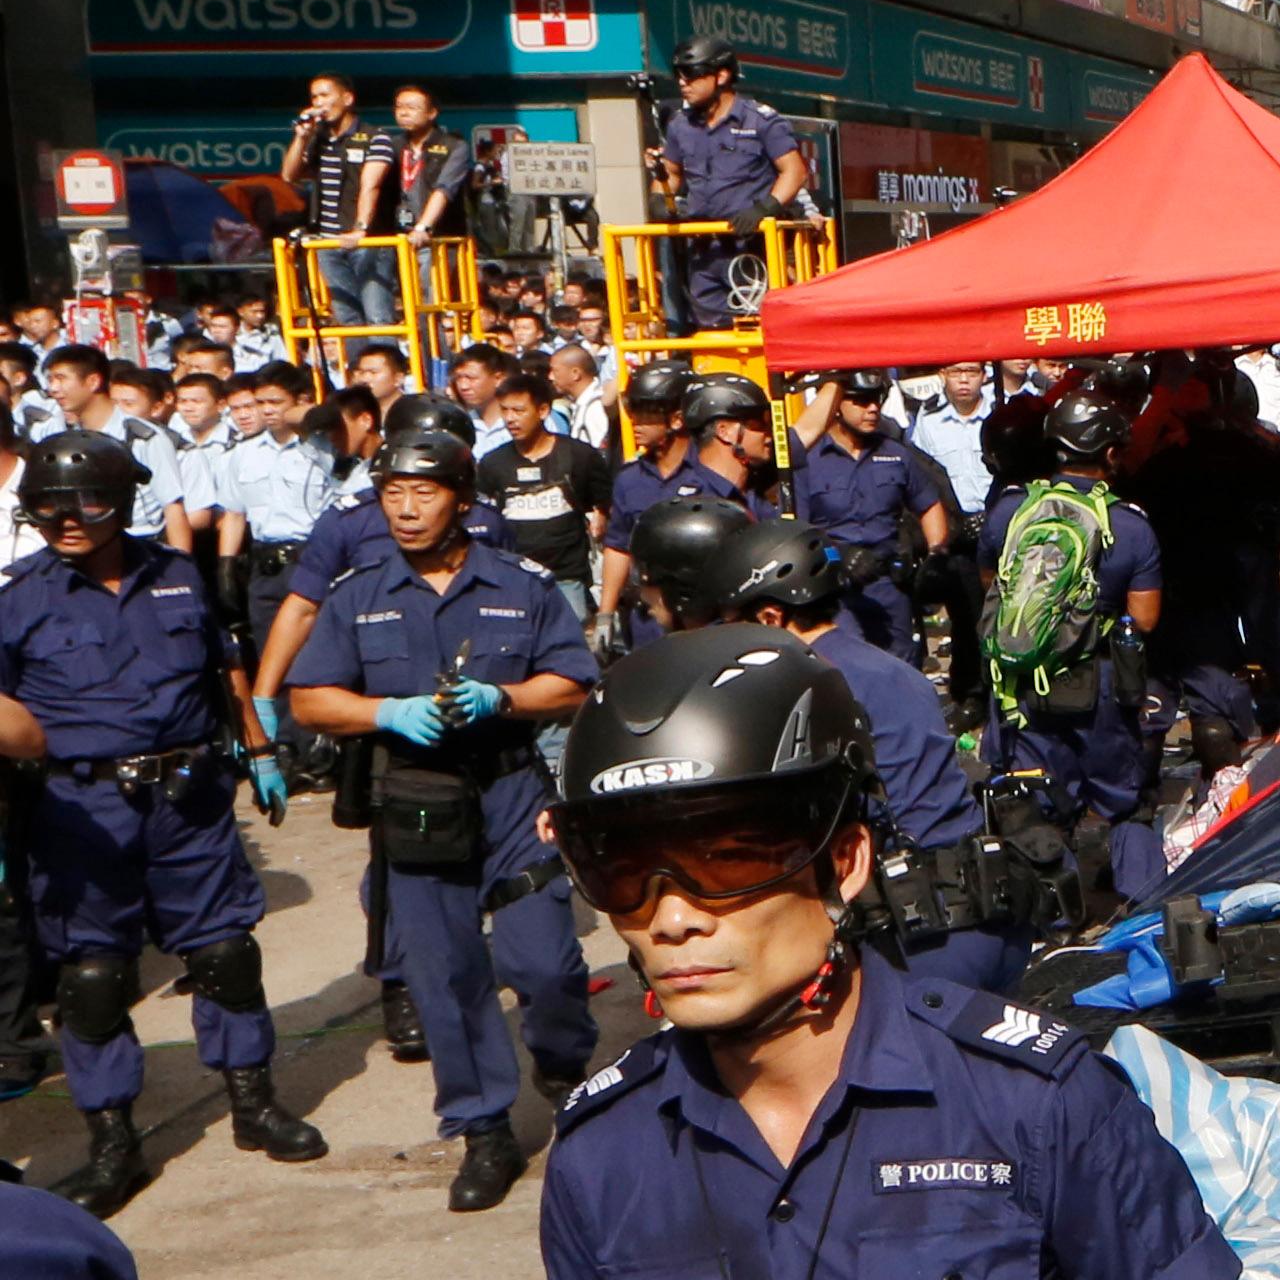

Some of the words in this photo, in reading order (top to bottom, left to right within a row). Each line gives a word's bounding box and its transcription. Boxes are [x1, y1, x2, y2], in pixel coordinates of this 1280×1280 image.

[688, 0, 789, 49] watsons
[798, 19, 838, 61] 屈臣氏
[920, 47, 985, 85] watsons
[988, 56, 1017, 93] 屈臣氏
[1087, 81, 1130, 108] watsons
[901, 166, 968, 209] mannings
[1024, 302, 1107, 346] 學聯
[507, 494, 559, 510] POLICE
[603, 763, 698, 793] KASK
[1030, 1022, 1069, 1056] 10014
[879, 1164, 903, 1188] 警
[907, 1164, 988, 1184] POLICE
[991, 1162, 1013, 1186] 察
